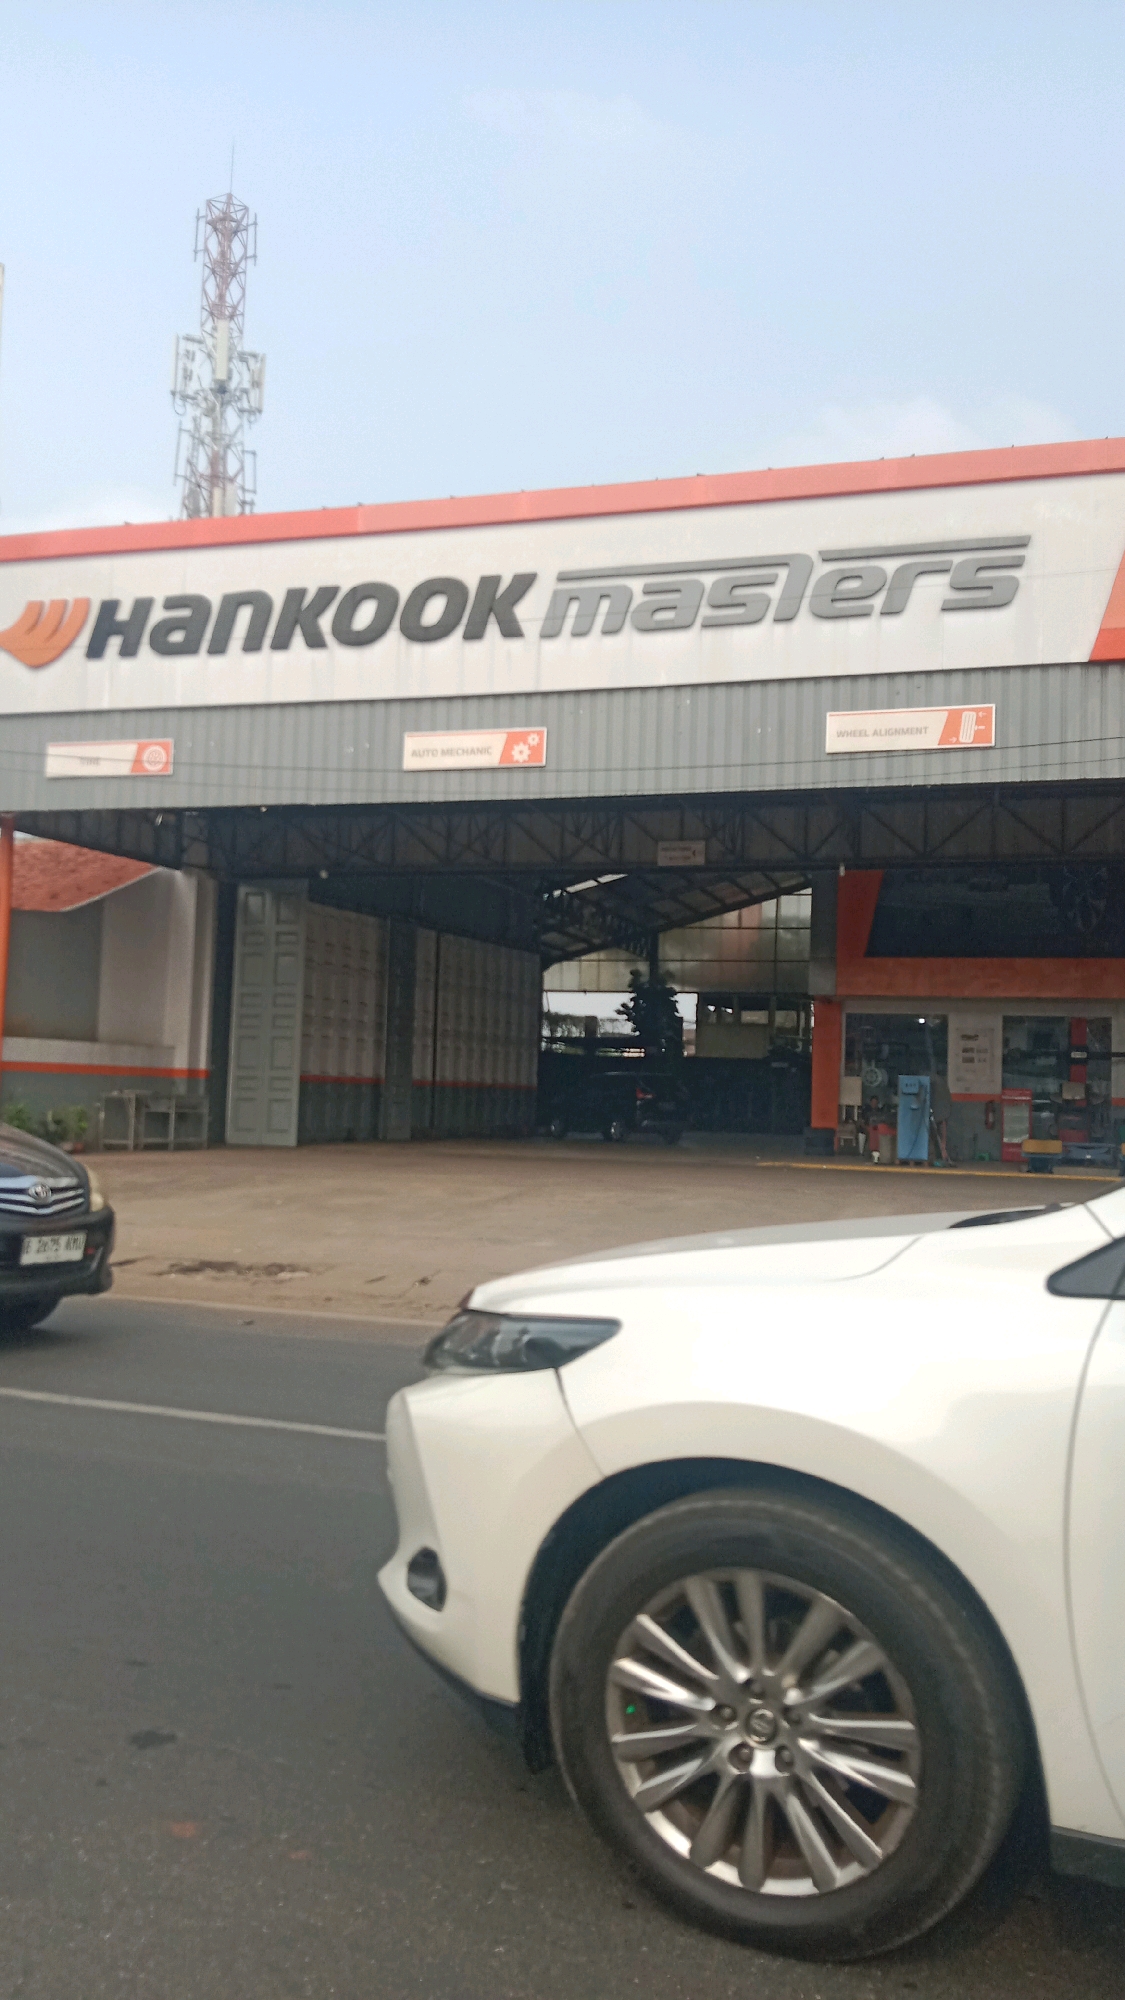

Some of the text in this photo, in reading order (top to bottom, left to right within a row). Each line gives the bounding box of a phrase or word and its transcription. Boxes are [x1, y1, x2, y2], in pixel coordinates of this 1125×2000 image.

[836, 726, 930, 739] WHEEL ALIGNMENT
[411, 746, 492, 759] AUTO MECHANIC
